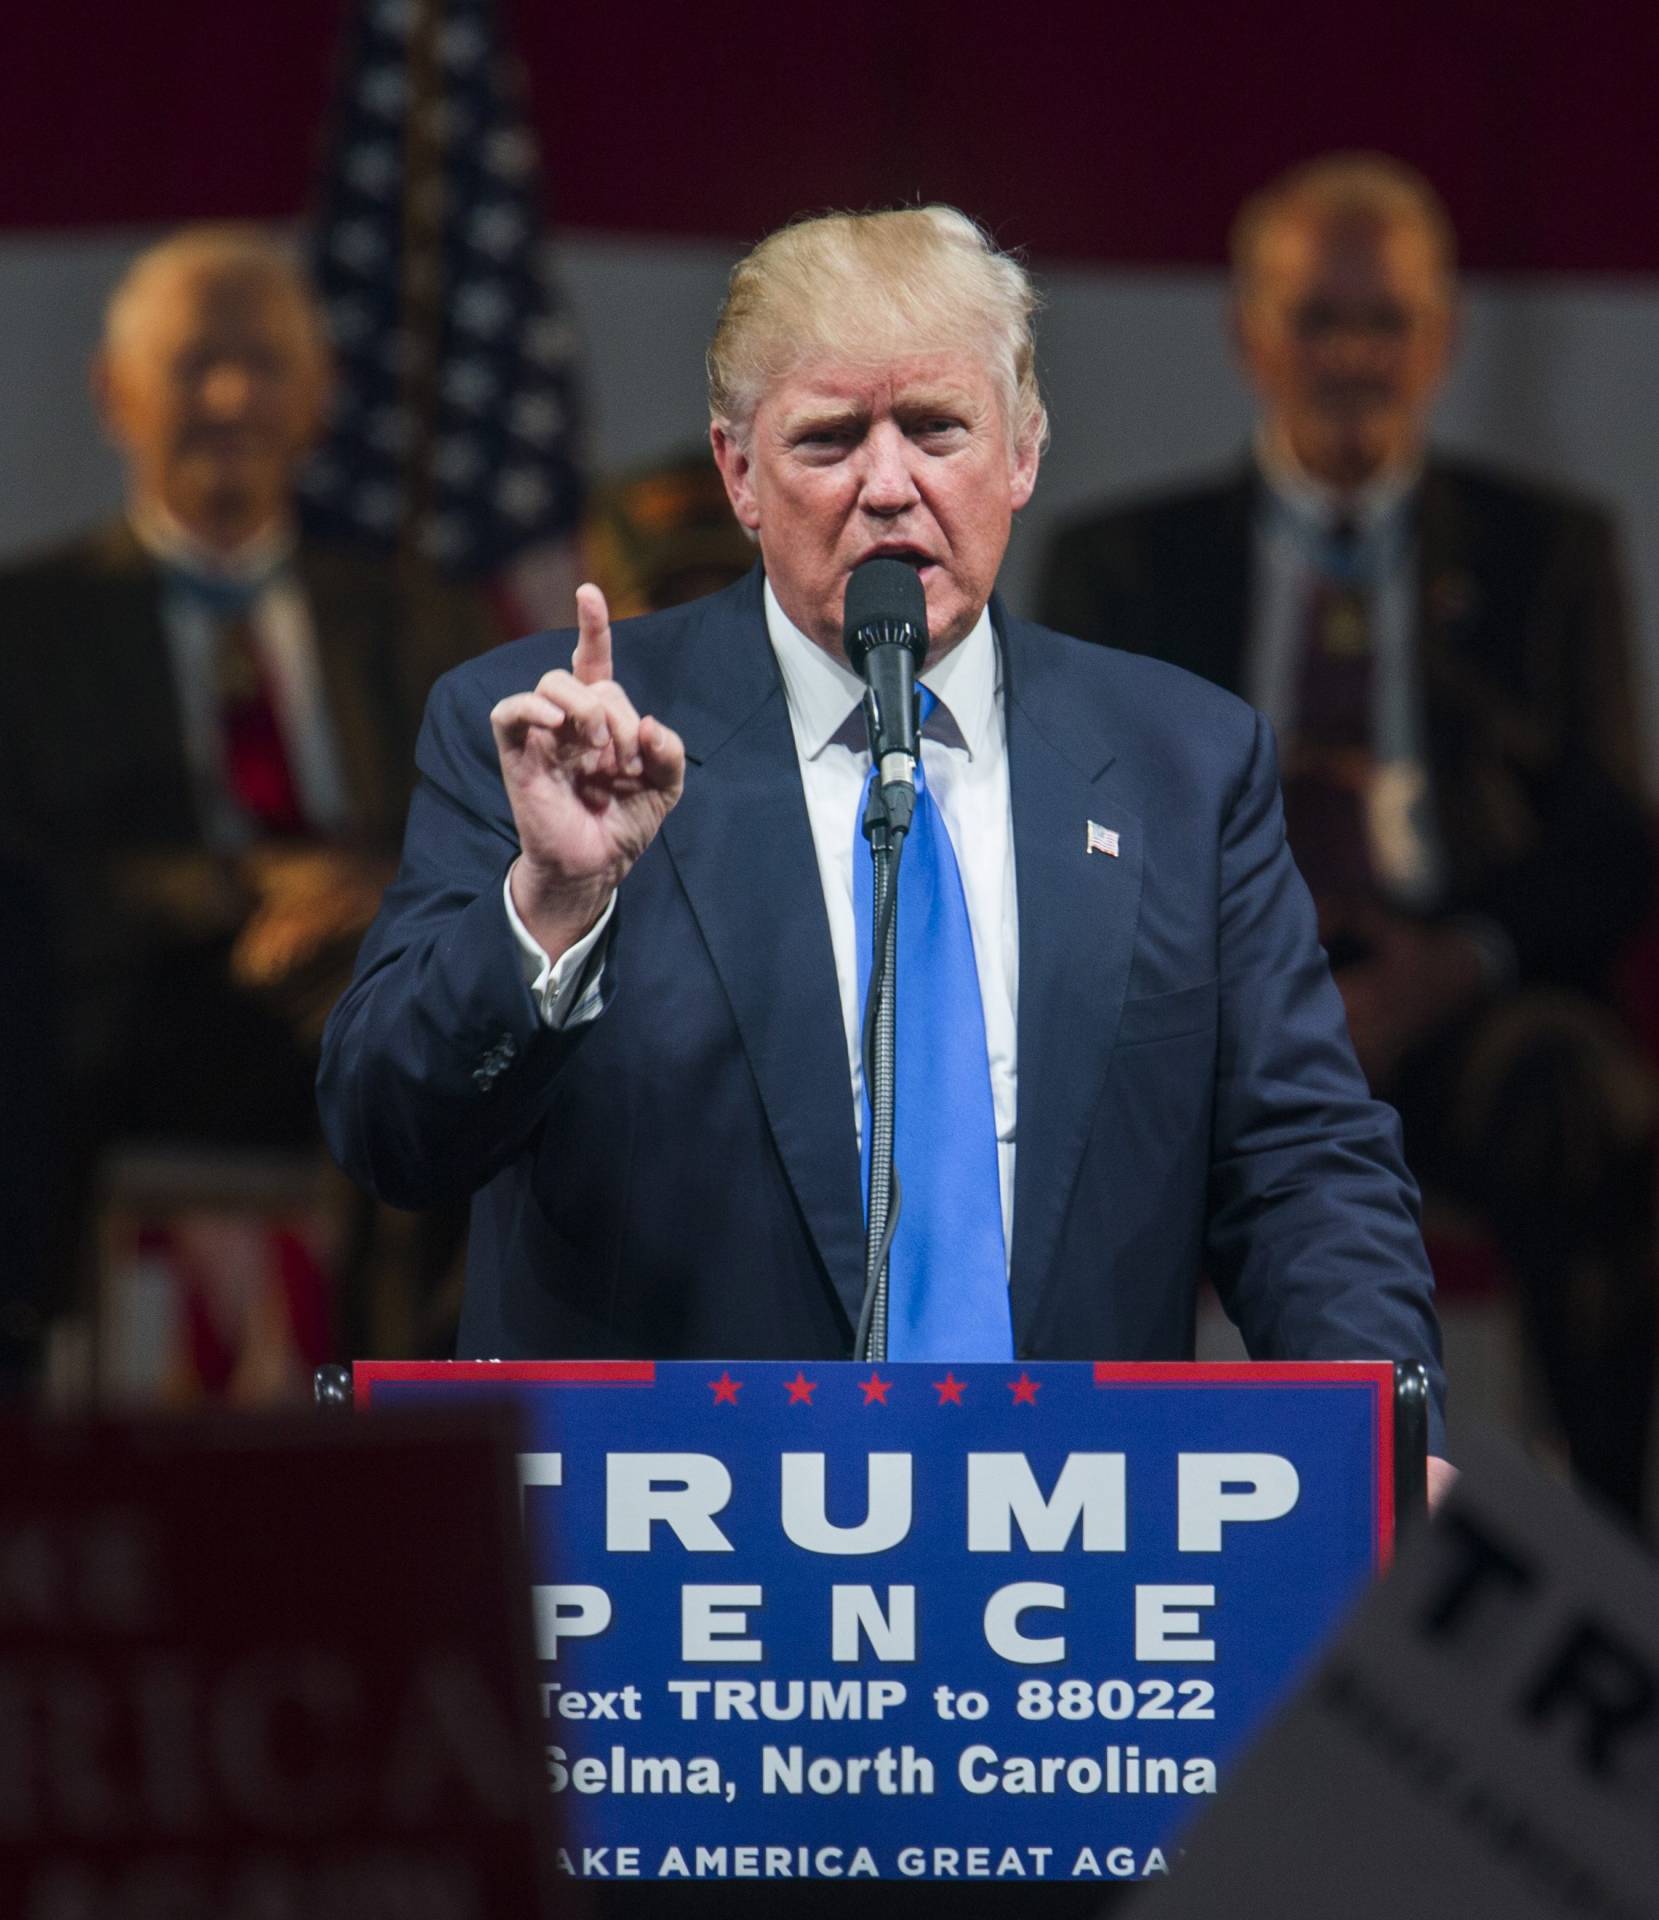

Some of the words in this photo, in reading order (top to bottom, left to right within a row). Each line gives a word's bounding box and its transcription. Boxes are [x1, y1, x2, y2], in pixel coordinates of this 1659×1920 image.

[532, 1581, 1216, 1664] PENCE
[667, 1681, 907, 1720] TRUMP
[934, 1685, 989, 1720] to
[1016, 1680, 1215, 1720] 88022
[762, 1746, 934, 1795] North
[958, 1744, 1217, 1795] Carolina
[556, 1847, 640, 1876] AKE
[658, 1847, 880, 1877] AMERICA
[897, 1847, 1053, 1877] GREAT
[1072, 1847, 1187, 1877] AGA
